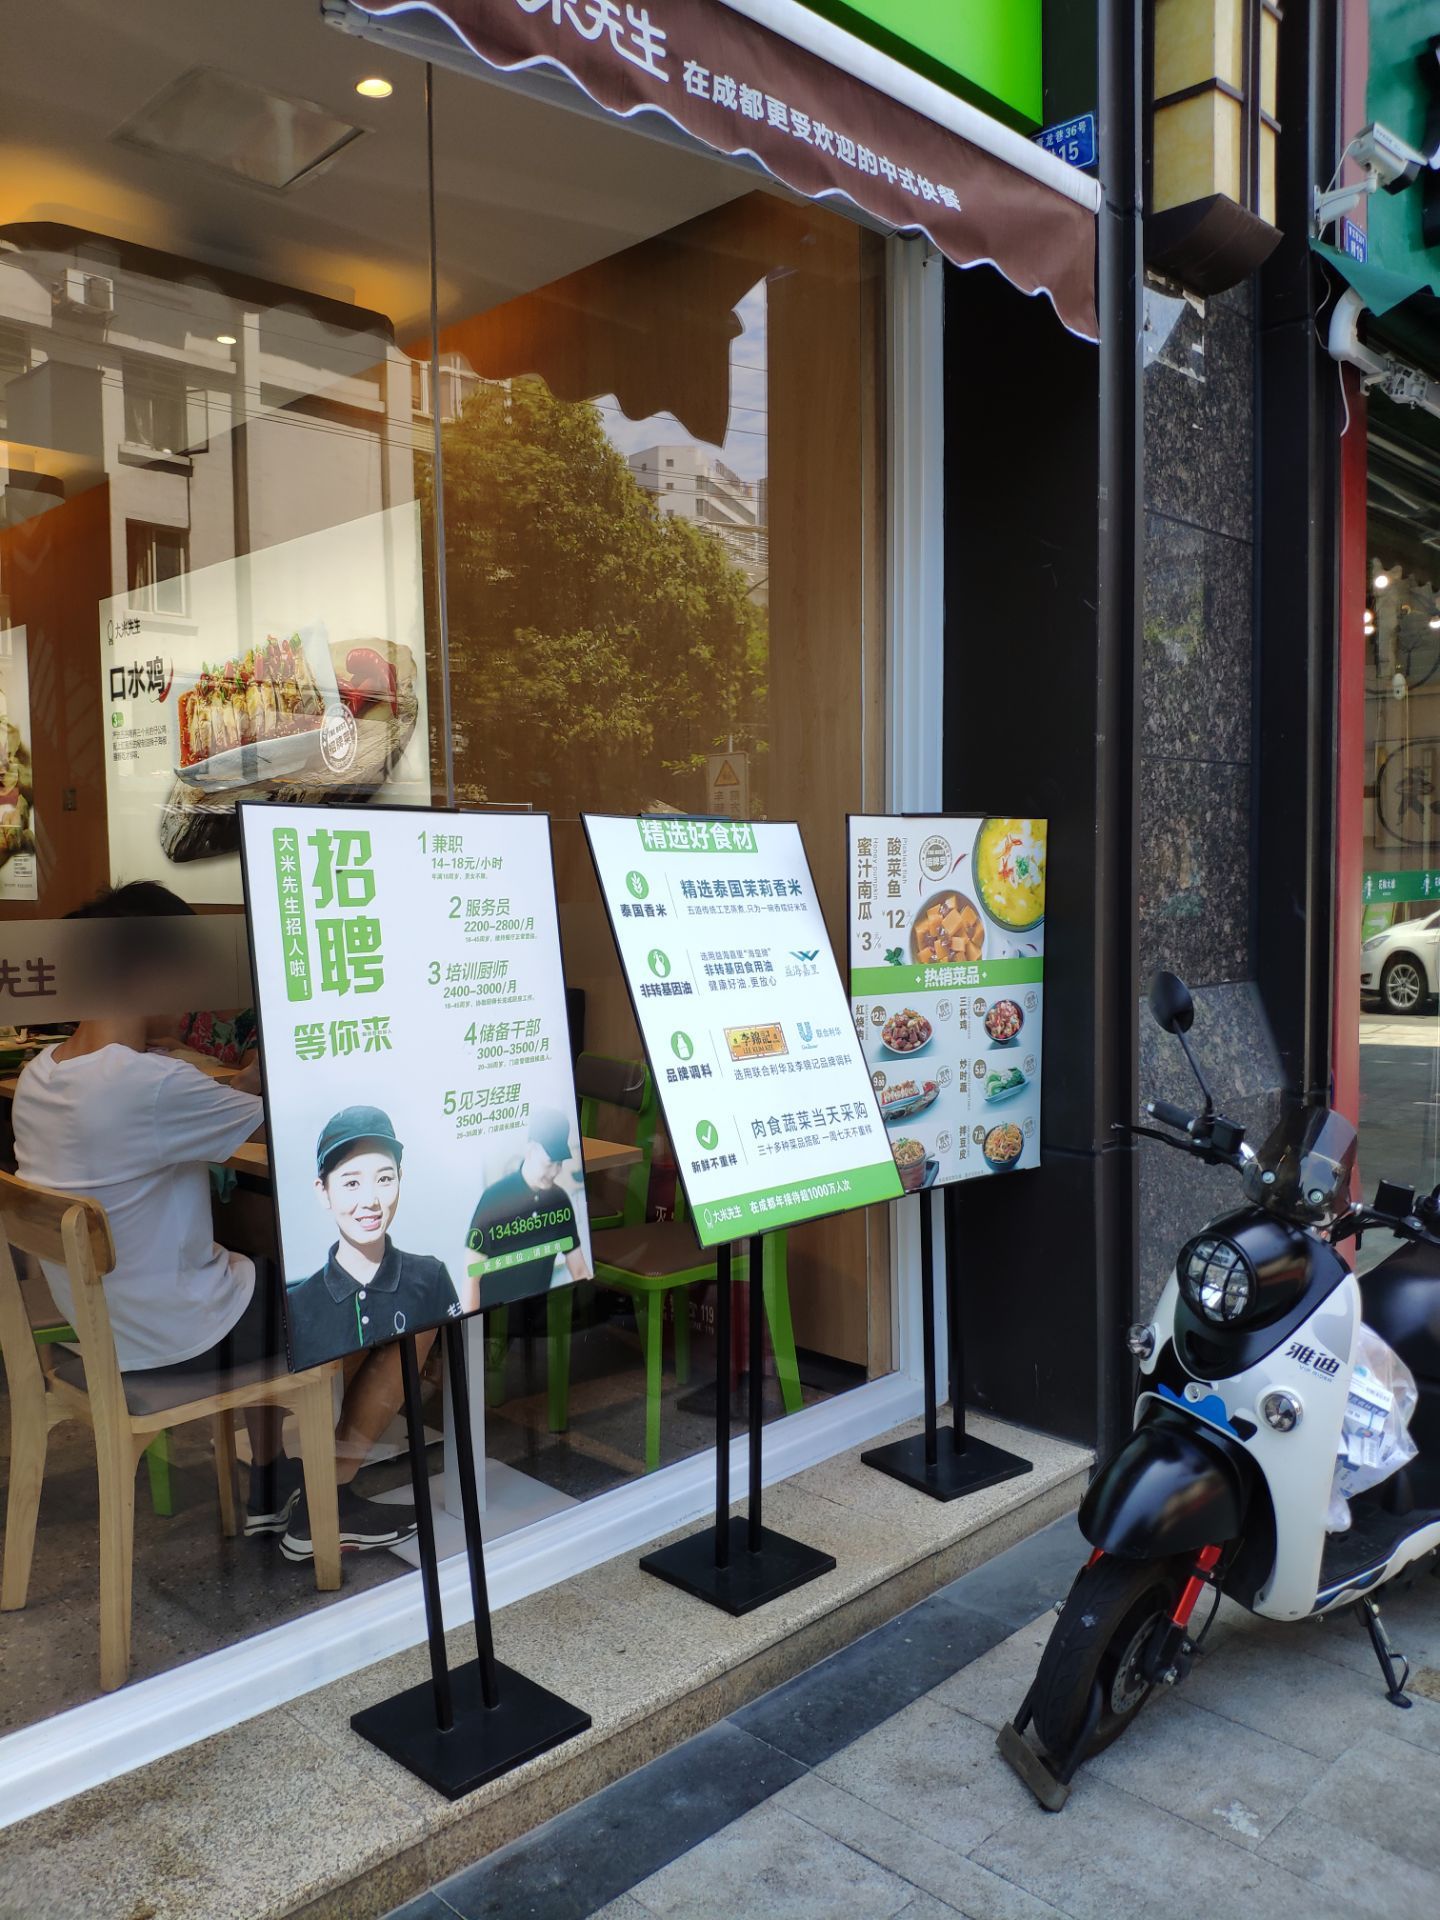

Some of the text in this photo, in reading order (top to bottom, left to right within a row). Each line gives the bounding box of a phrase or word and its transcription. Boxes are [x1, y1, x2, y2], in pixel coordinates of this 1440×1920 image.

[682, 59, 963, 213] 在成都更受欢迎的中式快餐
[1048, 140, 1080, 162] 15
[115, 618, 141, 639] 大米先生
[109, 656, 165, 702] 口水鸡
[417, 830, 427, 854] 1
[432, 834, 463, 853] 兼职
[640, 819, 754, 850] 精选好食材
[857, 837, 872, 920] 蜜汁南瓜
[887, 837, 901, 898] 酸菜鱼
[680, 878, 802, 899] 精选泰国茉莉香米
[307, 829, 384, 997] 招聘
[448, 895, 461, 918] 2
[465, 898, 510, 917] 服务员
[620, 903, 667, 918] 泰国香米
[464, 917, 534, 932] 2200-2800/月
[427, 961, 441, 985] 3
[445, 959, 509, 982] 培训厨师
[703, 960, 774, 977] 非转基因食用油
[924, 965, 979, 988] 热销菜品
[443, 979, 517, 998] 2400-3000/月
[640, 981, 694, 998] 非转基因油
[294, 1016, 392, 1061] 等你来
[464, 1021, 477, 1046] 4
[479, 1018, 541, 1044] 储备干部
[477, 1037, 550, 1060] 3000-3500/月
[666, 1063, 713, 1083] 品牌调料
[443, 1090, 457, 1115] 5
[457, 1083, 521, 1112] 见习经理
[456, 1102, 530, 1128] 3500-4300/月
[751, 1101, 869, 1139] 肉食蔬菜当天采购
[691, 1153, 738, 1174] 新鲜不重样
[713, 1179, 851, 1223] 大米先生 在成都年接待超1000万人次
[488, 1207, 571, 1241] 13438657050
[1285, 1342, 1340, 1377] 雅迪
